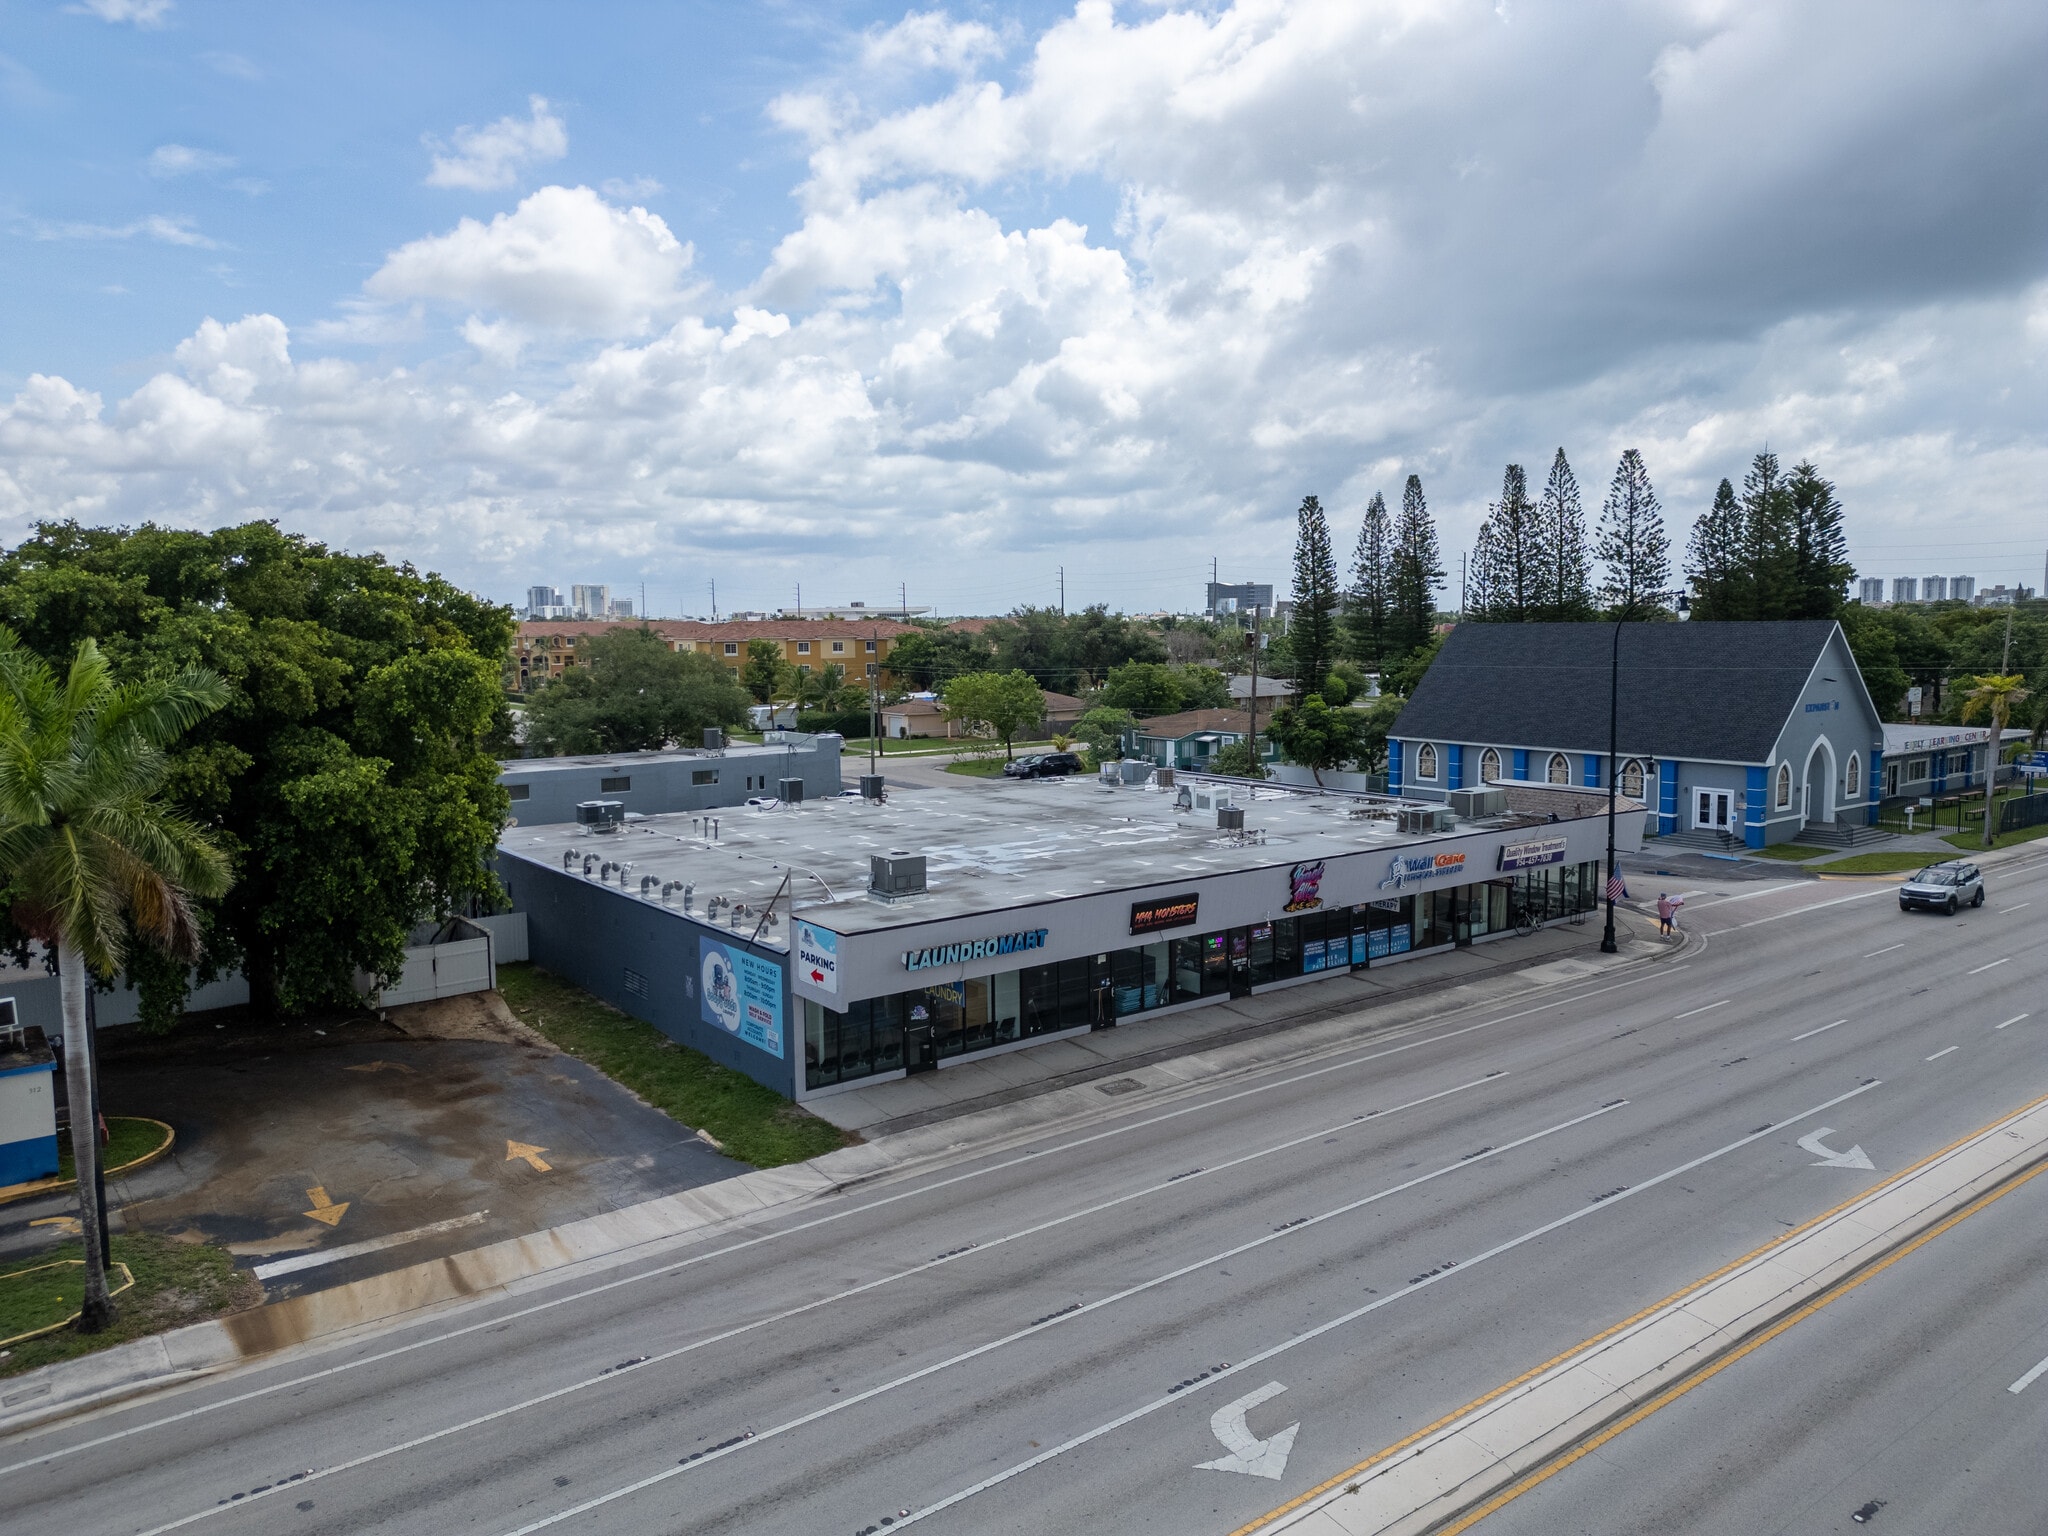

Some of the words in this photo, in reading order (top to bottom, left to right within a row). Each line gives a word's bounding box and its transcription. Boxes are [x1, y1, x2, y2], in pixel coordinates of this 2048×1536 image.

[1929, 734, 1959, 748] LEARING
[1435, 853, 1465, 867] Care
[1154, 902, 1197, 920] MONSTERS
[904, 928, 1048, 971] LAUNDROMART
[742, 957, 755, 969] NEW
[757, 963, 777, 978] HOURS
[800, 950, 835, 972] PARKING
[925, 984, 963, 1005] LAUNDRY
